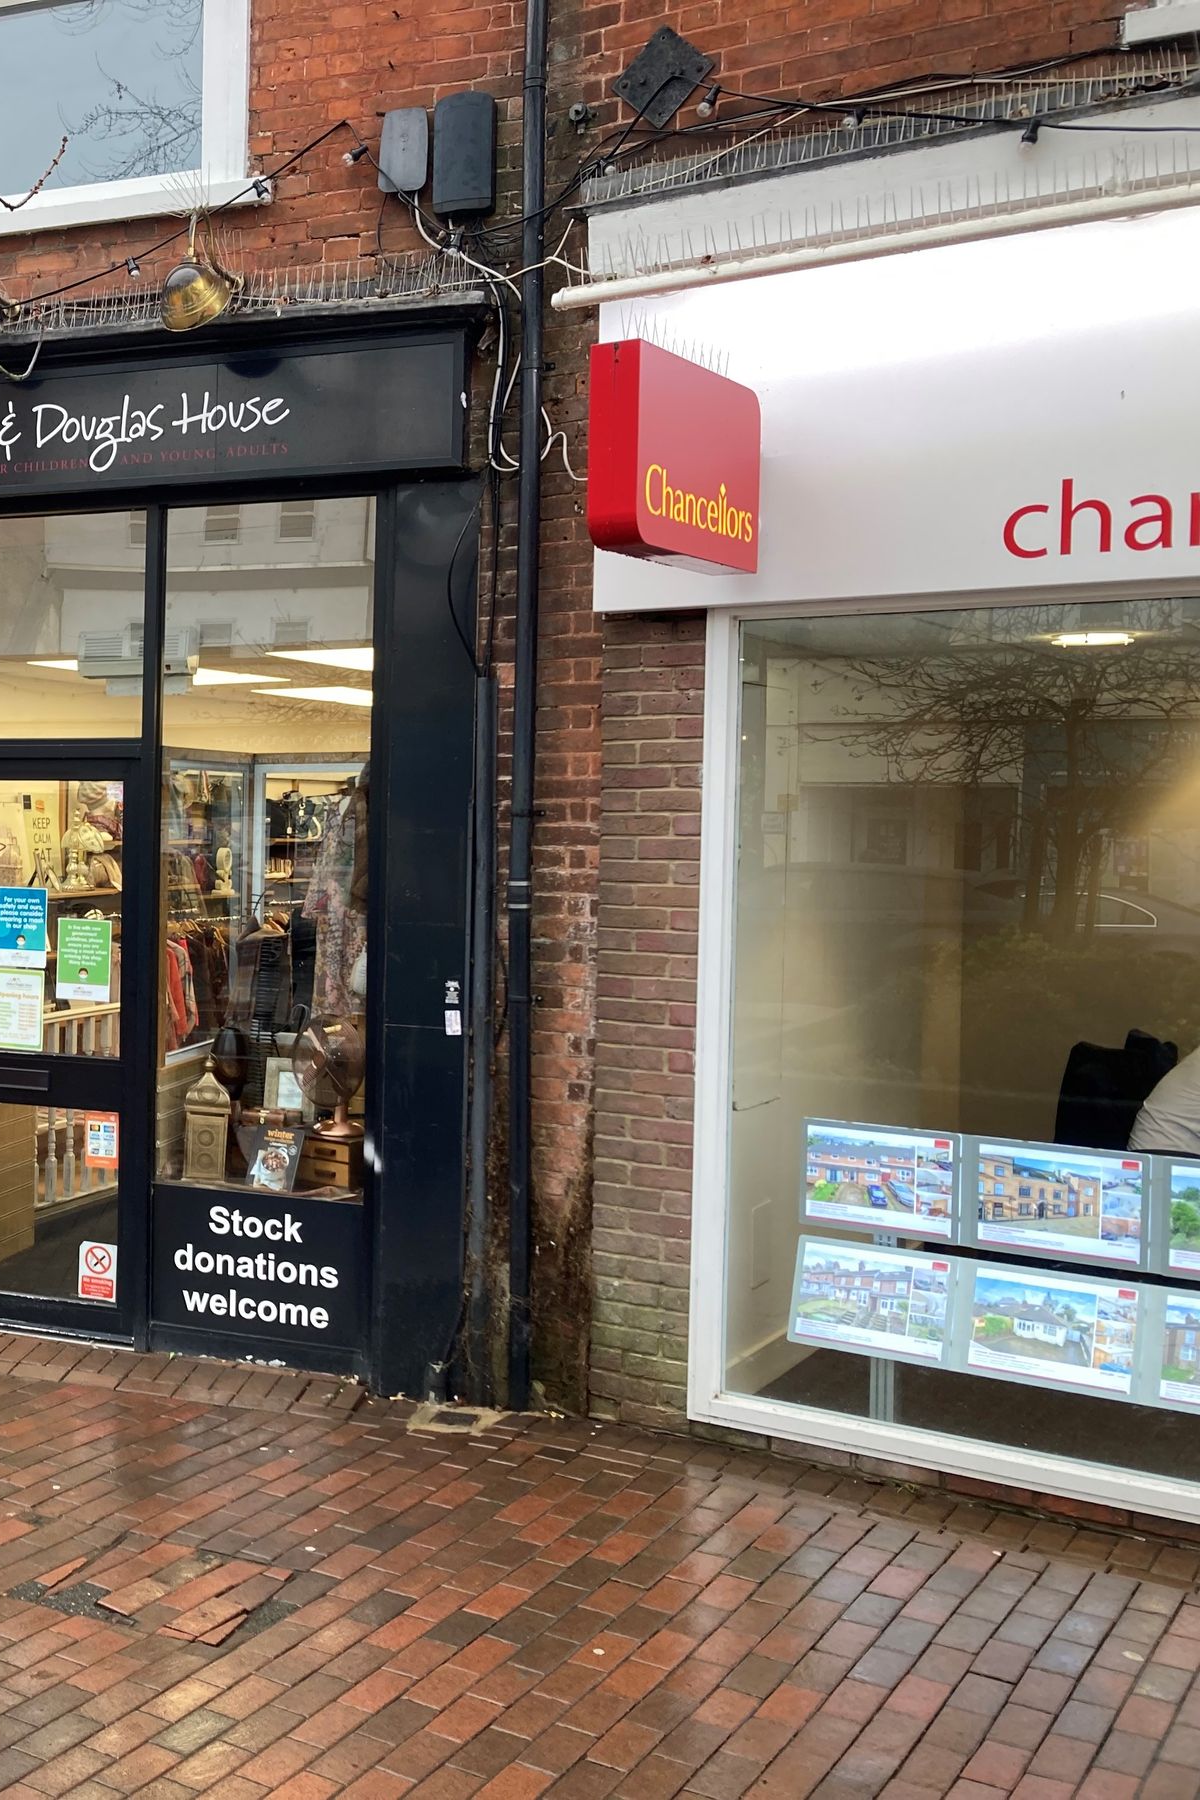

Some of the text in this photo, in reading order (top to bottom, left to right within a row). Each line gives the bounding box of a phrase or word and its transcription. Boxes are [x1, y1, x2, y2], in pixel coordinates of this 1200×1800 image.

[31, 395, 164, 472] Douglas
[171, 391, 290, 434] House
[14, 459, 88, 473] CHILDREN
[120, 453, 153, 465] AND
[160, 449, 215, 462] YOUNG
[226, 443, 289, 457] ADULTS
[645, 463, 753, 543] Chancellors
[32, 817, 51, 830] KEEP
[33, 833, 52, 845] CALM
[0, 902, 16, 911] safety
[0, 916, 23, 924] wearing
[23, 923, 38, 931] shop
[267, 1128, 295, 1140] winter
[208, 1205, 303, 1243] Stock
[174, 1243, 339, 1289] donations
[182, 1289, 330, 1329] welcome
